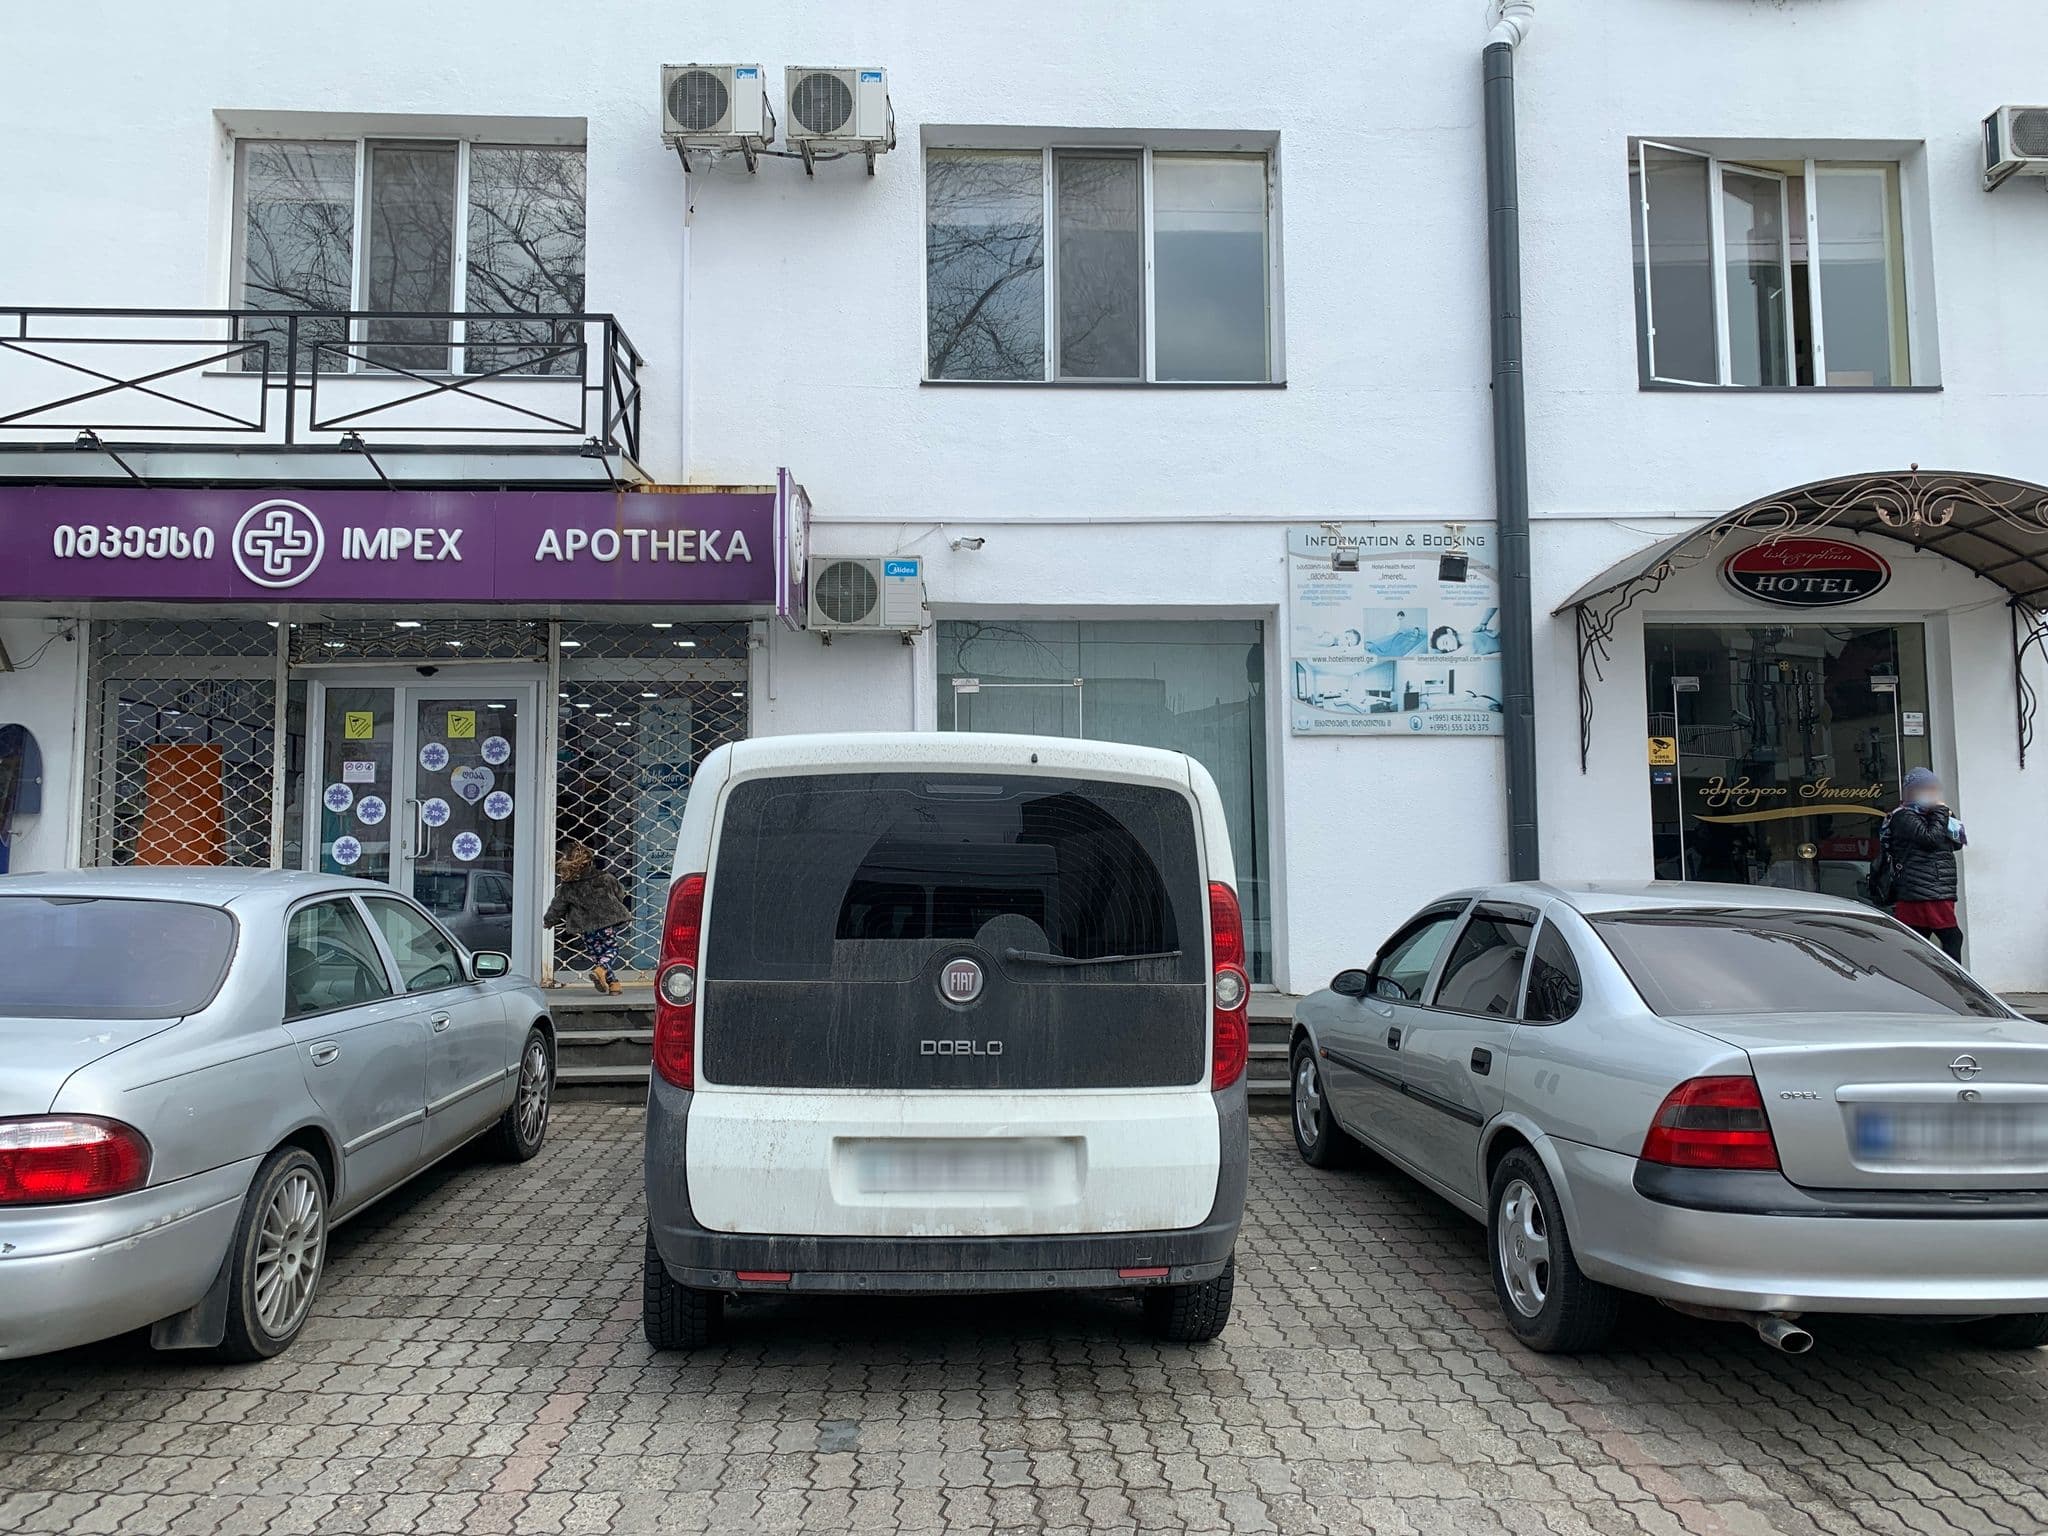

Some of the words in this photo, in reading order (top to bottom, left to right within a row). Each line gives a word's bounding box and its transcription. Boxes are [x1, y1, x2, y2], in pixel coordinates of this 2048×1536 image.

[53, 525, 215, 559] იმპექსი
[342, 527, 463, 560] IMPEX
[534, 528, 752, 562] APOTHEKA
[1405, 534, 1416, 546] &
[1756, 577, 1860, 593] HOTEL
[1452, 723, 1463, 731] 555
[1698, 776, 1788, 807] იმერეთი
[1799, 777, 1883, 799] Imereti
[950, 972, 975, 991] FIAT
[920, 1040, 1003, 1055] DOBLO
[1780, 1090, 1824, 1101] OPEL
